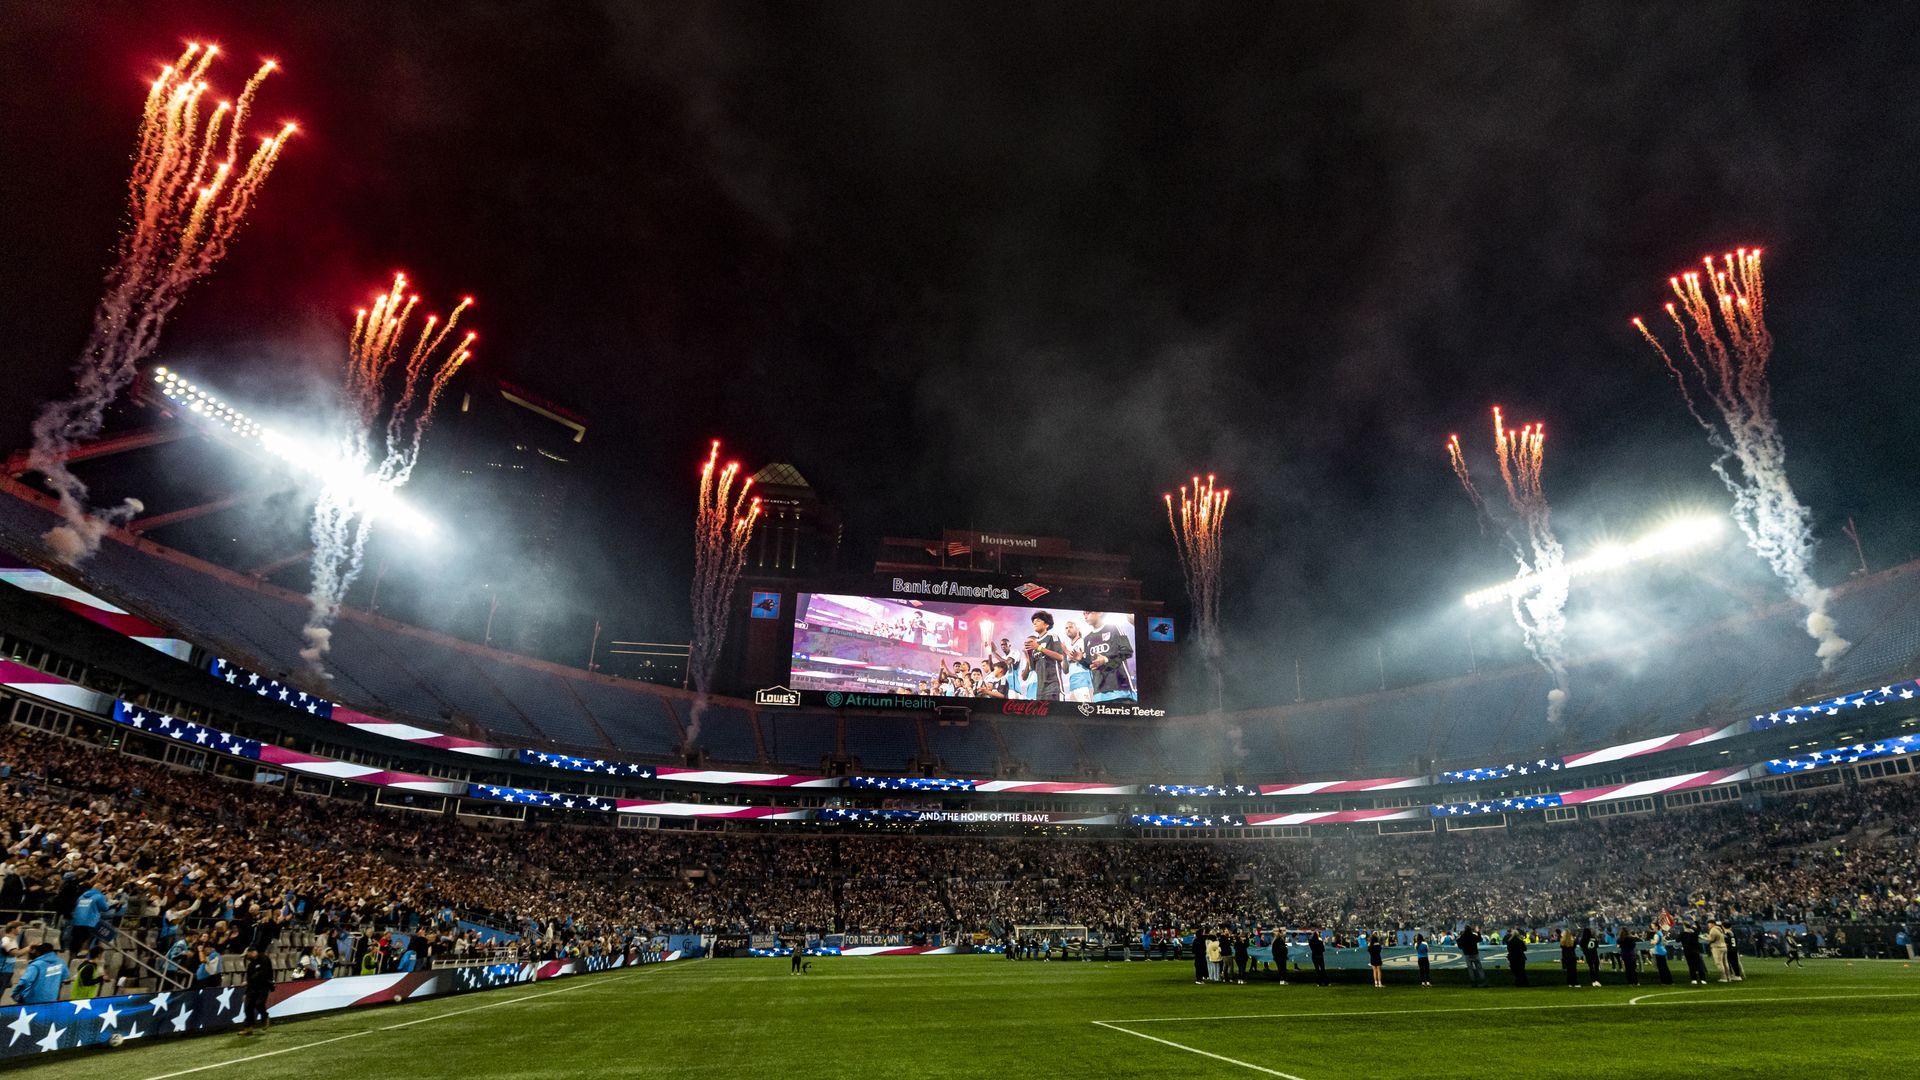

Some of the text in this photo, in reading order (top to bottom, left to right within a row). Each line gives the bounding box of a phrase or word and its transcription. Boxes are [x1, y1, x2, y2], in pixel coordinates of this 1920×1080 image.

[981, 535, 1037, 548] Honeywell
[892, 578, 1010, 599] Bank of America
[760, 692, 796, 704] LOWE'S
[846, 693, 936, 710] Atrium Health
[1096, 704, 1166, 717] Harris Teeter
[918, 812, 1049, 822] AND THE HOME OF THE BRAVE
[845, 935, 899, 945] FOR THE CRWN
